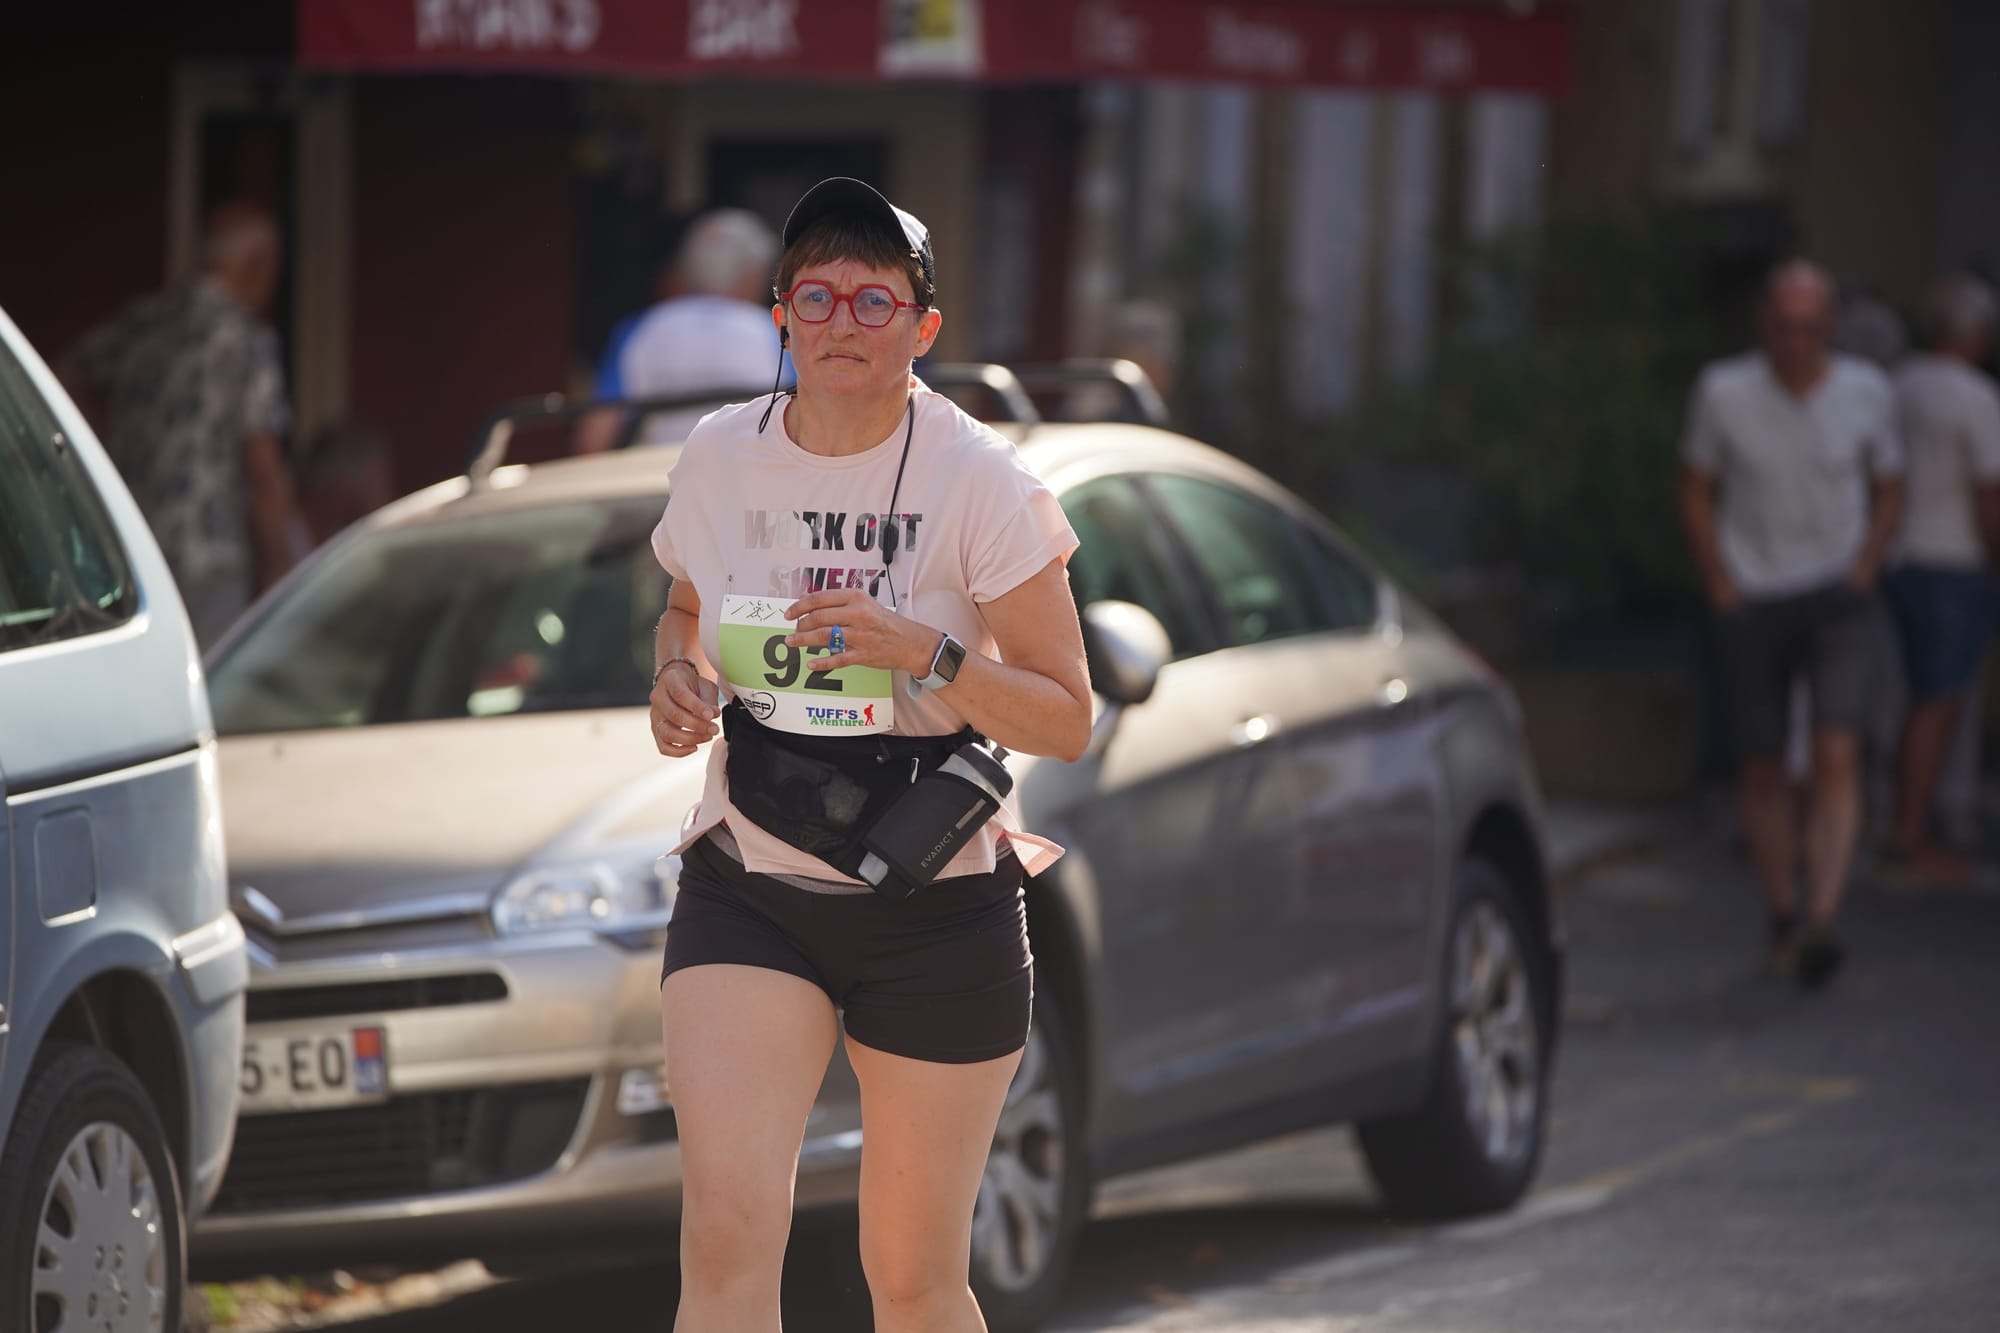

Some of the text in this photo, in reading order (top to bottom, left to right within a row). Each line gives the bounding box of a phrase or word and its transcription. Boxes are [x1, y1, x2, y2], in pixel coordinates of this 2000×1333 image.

[762, 634, 843, 692] 92
[805, 706, 859, 720] TUFF'S
[810, 715, 865, 727] Aventure
[920, 831, 954, 868] EVADICT
